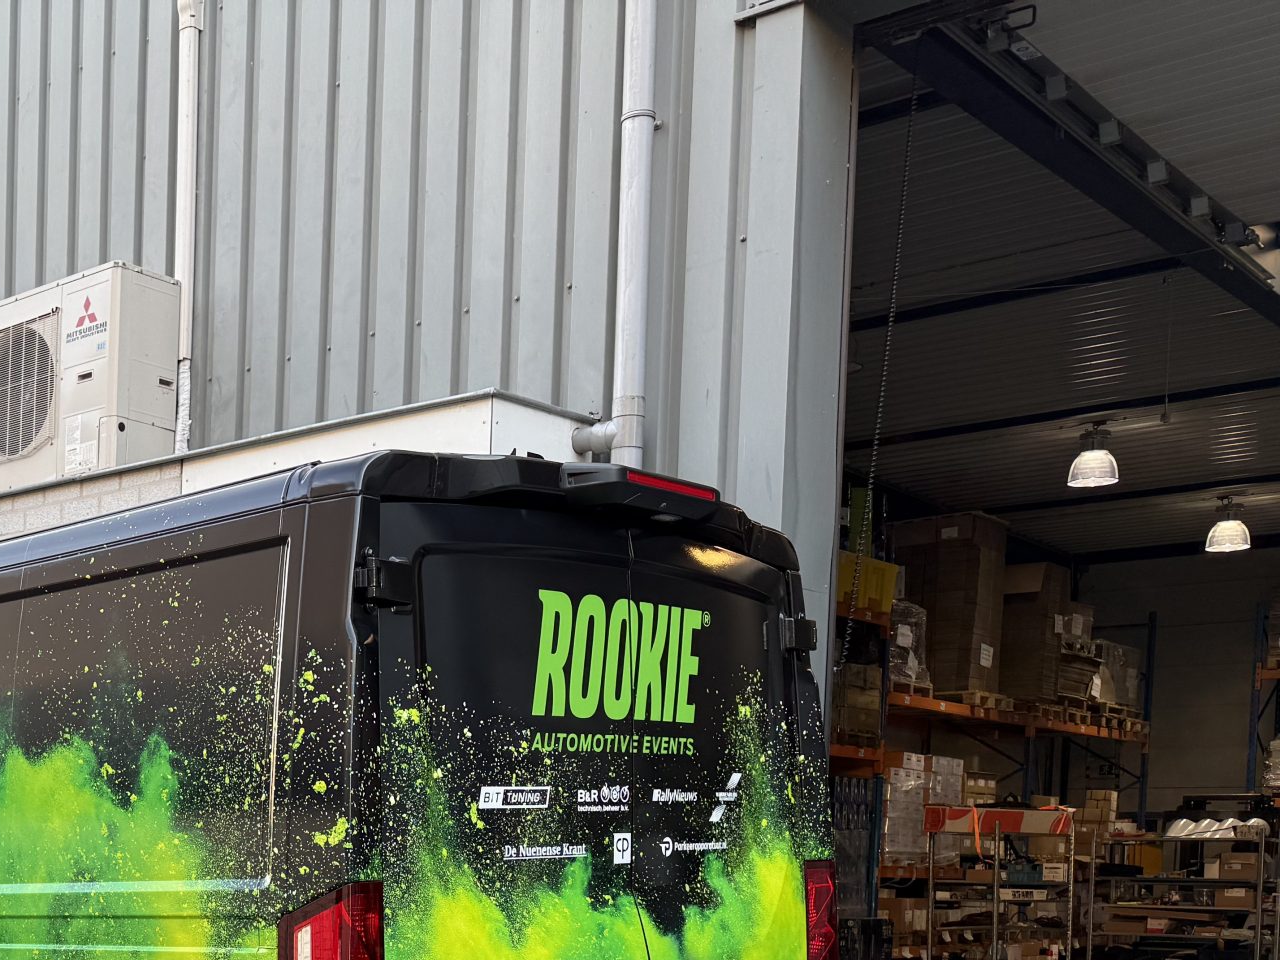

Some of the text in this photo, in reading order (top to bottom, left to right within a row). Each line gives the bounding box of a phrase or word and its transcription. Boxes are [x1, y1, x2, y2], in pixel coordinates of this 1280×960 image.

[66, 321, 107, 339] MITSUBISHI
[532, 732, 694, 757] AUTOMOTIVE EVENTS
[483, 792, 541, 803] BIT TUNING
[577, 789, 599, 803] B&R
[504, 843, 586, 857] De Nuenense Krant
